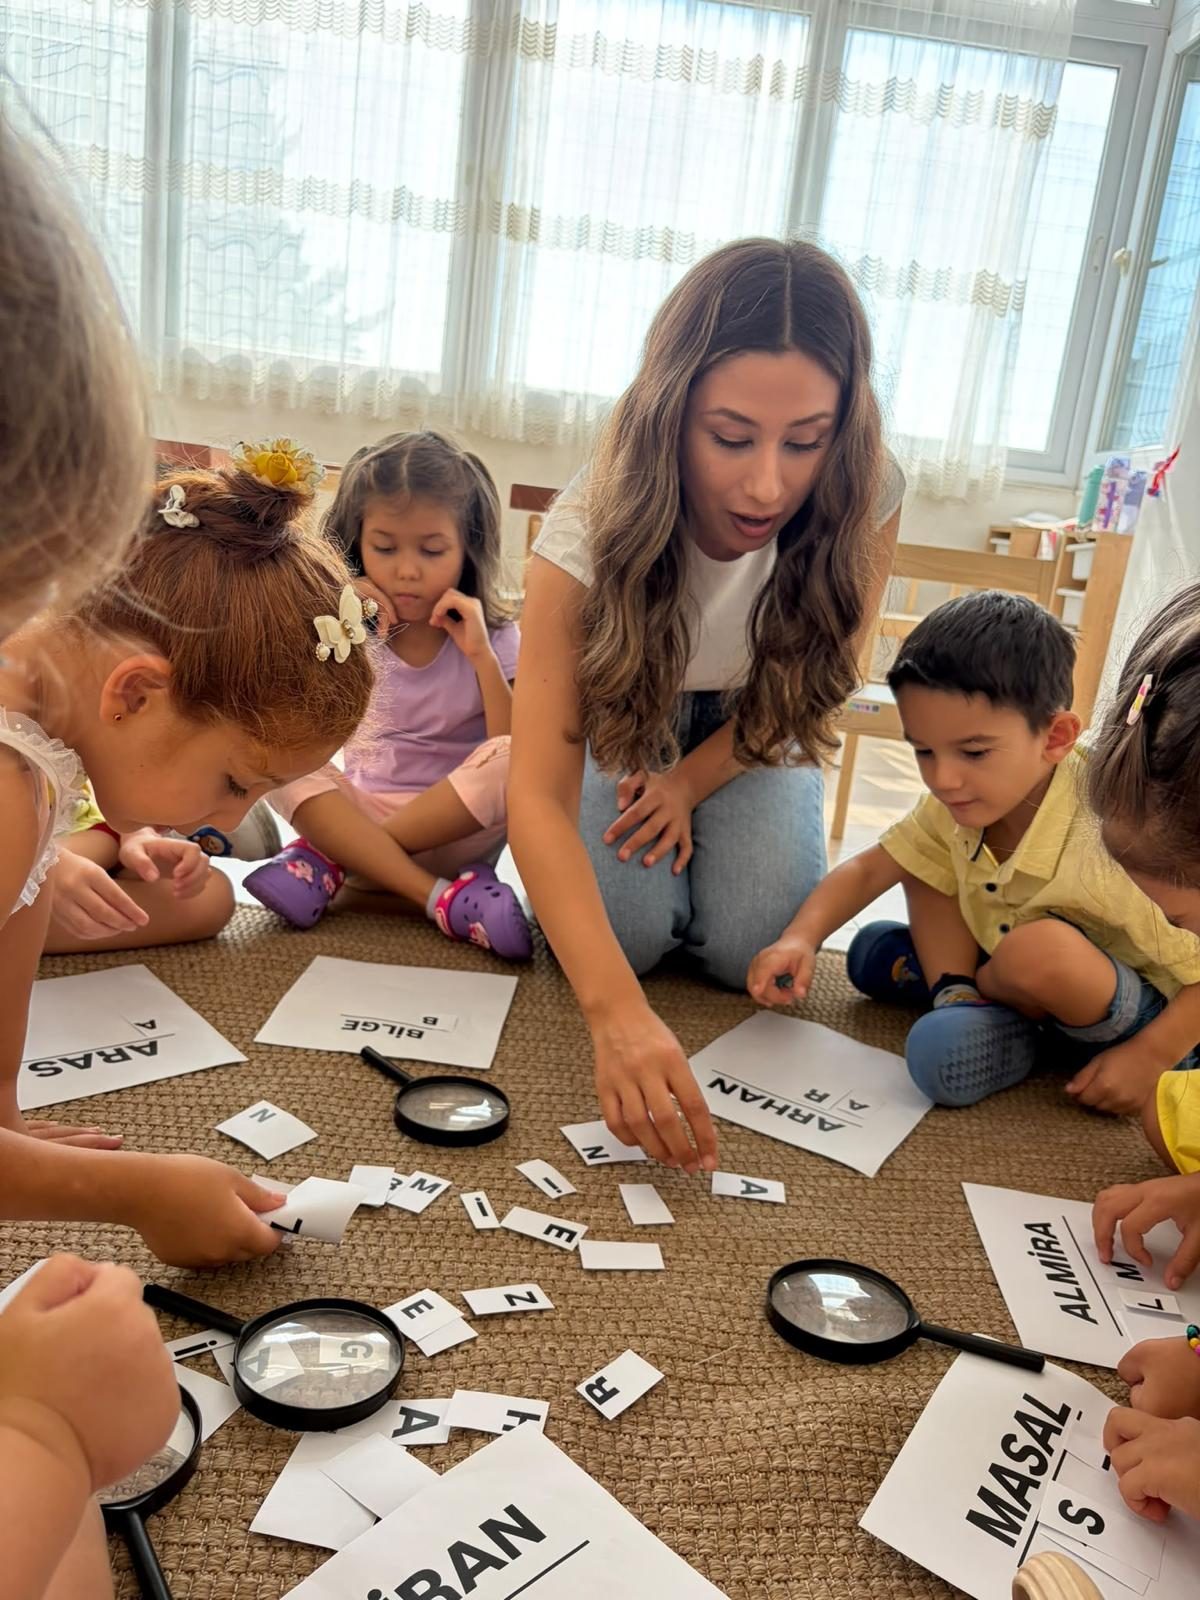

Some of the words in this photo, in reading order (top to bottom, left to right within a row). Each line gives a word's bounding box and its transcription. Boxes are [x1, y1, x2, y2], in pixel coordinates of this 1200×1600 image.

[134, 1019, 157, 1030] A
[341, 1019, 425, 1039] BİLGE
[28, 1040, 158, 1077] ARAS
[707, 1077, 846, 1132] ARHAN
[740, 1179, 769, 1195] A
[543, 1223, 578, 1243] E
[1024, 1222, 1099, 1325] ALMİRA
[1110, 1260, 1144, 1282] M
[401, 1299, 434, 1320] E
[1138, 1298, 1164, 1311] L
[340, 1340, 374, 1359] G
[585, 1376, 620, 1406] R
[392, 1406, 440, 1438] A
[965, 1393, 1071, 1548] MASAL
[1058, 1499, 1105, 1536] S
